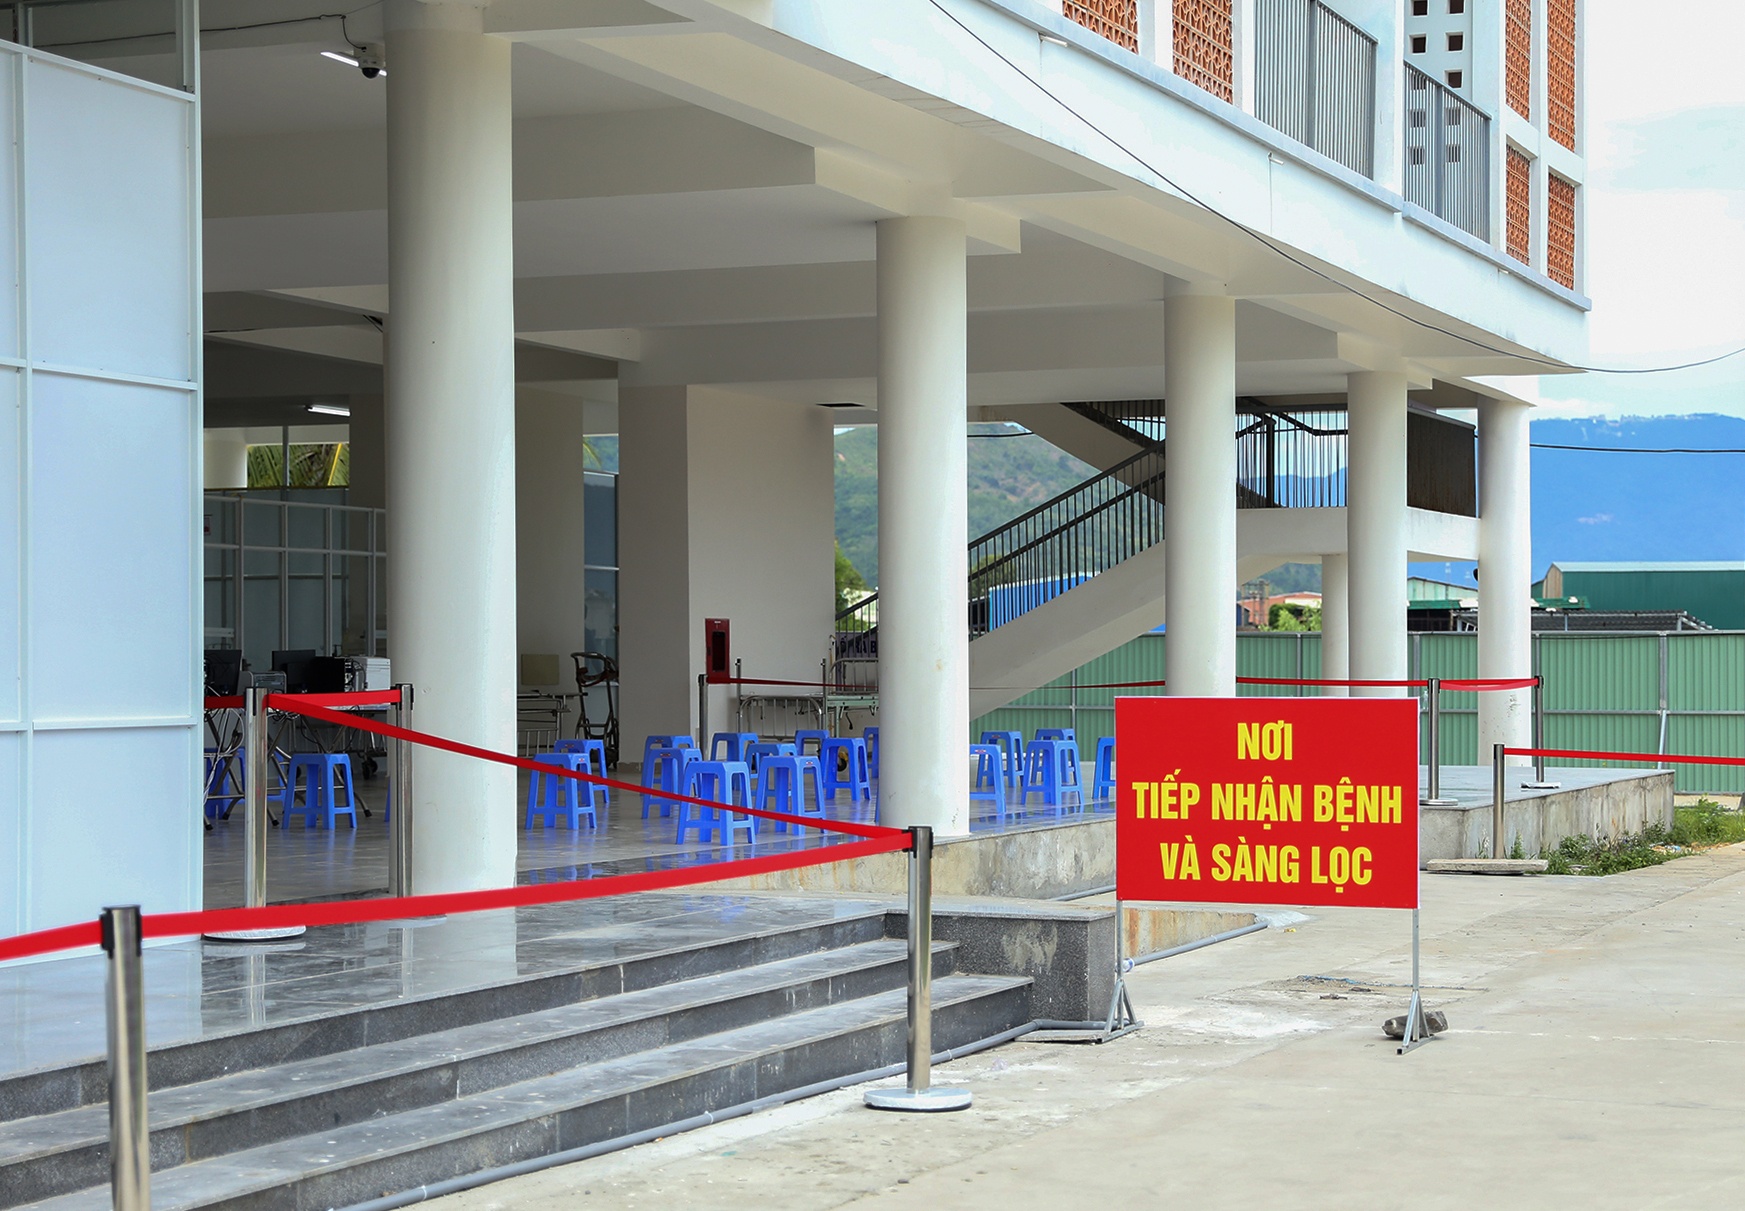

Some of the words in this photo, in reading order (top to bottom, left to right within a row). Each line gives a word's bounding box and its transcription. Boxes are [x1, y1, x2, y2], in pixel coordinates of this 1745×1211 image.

[1237, 719, 1293, 761] NƠI
[1131, 768, 1201, 820] TIẾP
[1211, 775, 1303, 831] NHẬN
[1313, 776, 1402, 832] BỆNH
[1159, 834, 1202, 881] VÀ
[1211, 835, 1300, 884] SÀNG
[1311, 845, 1373, 894] LỌC
